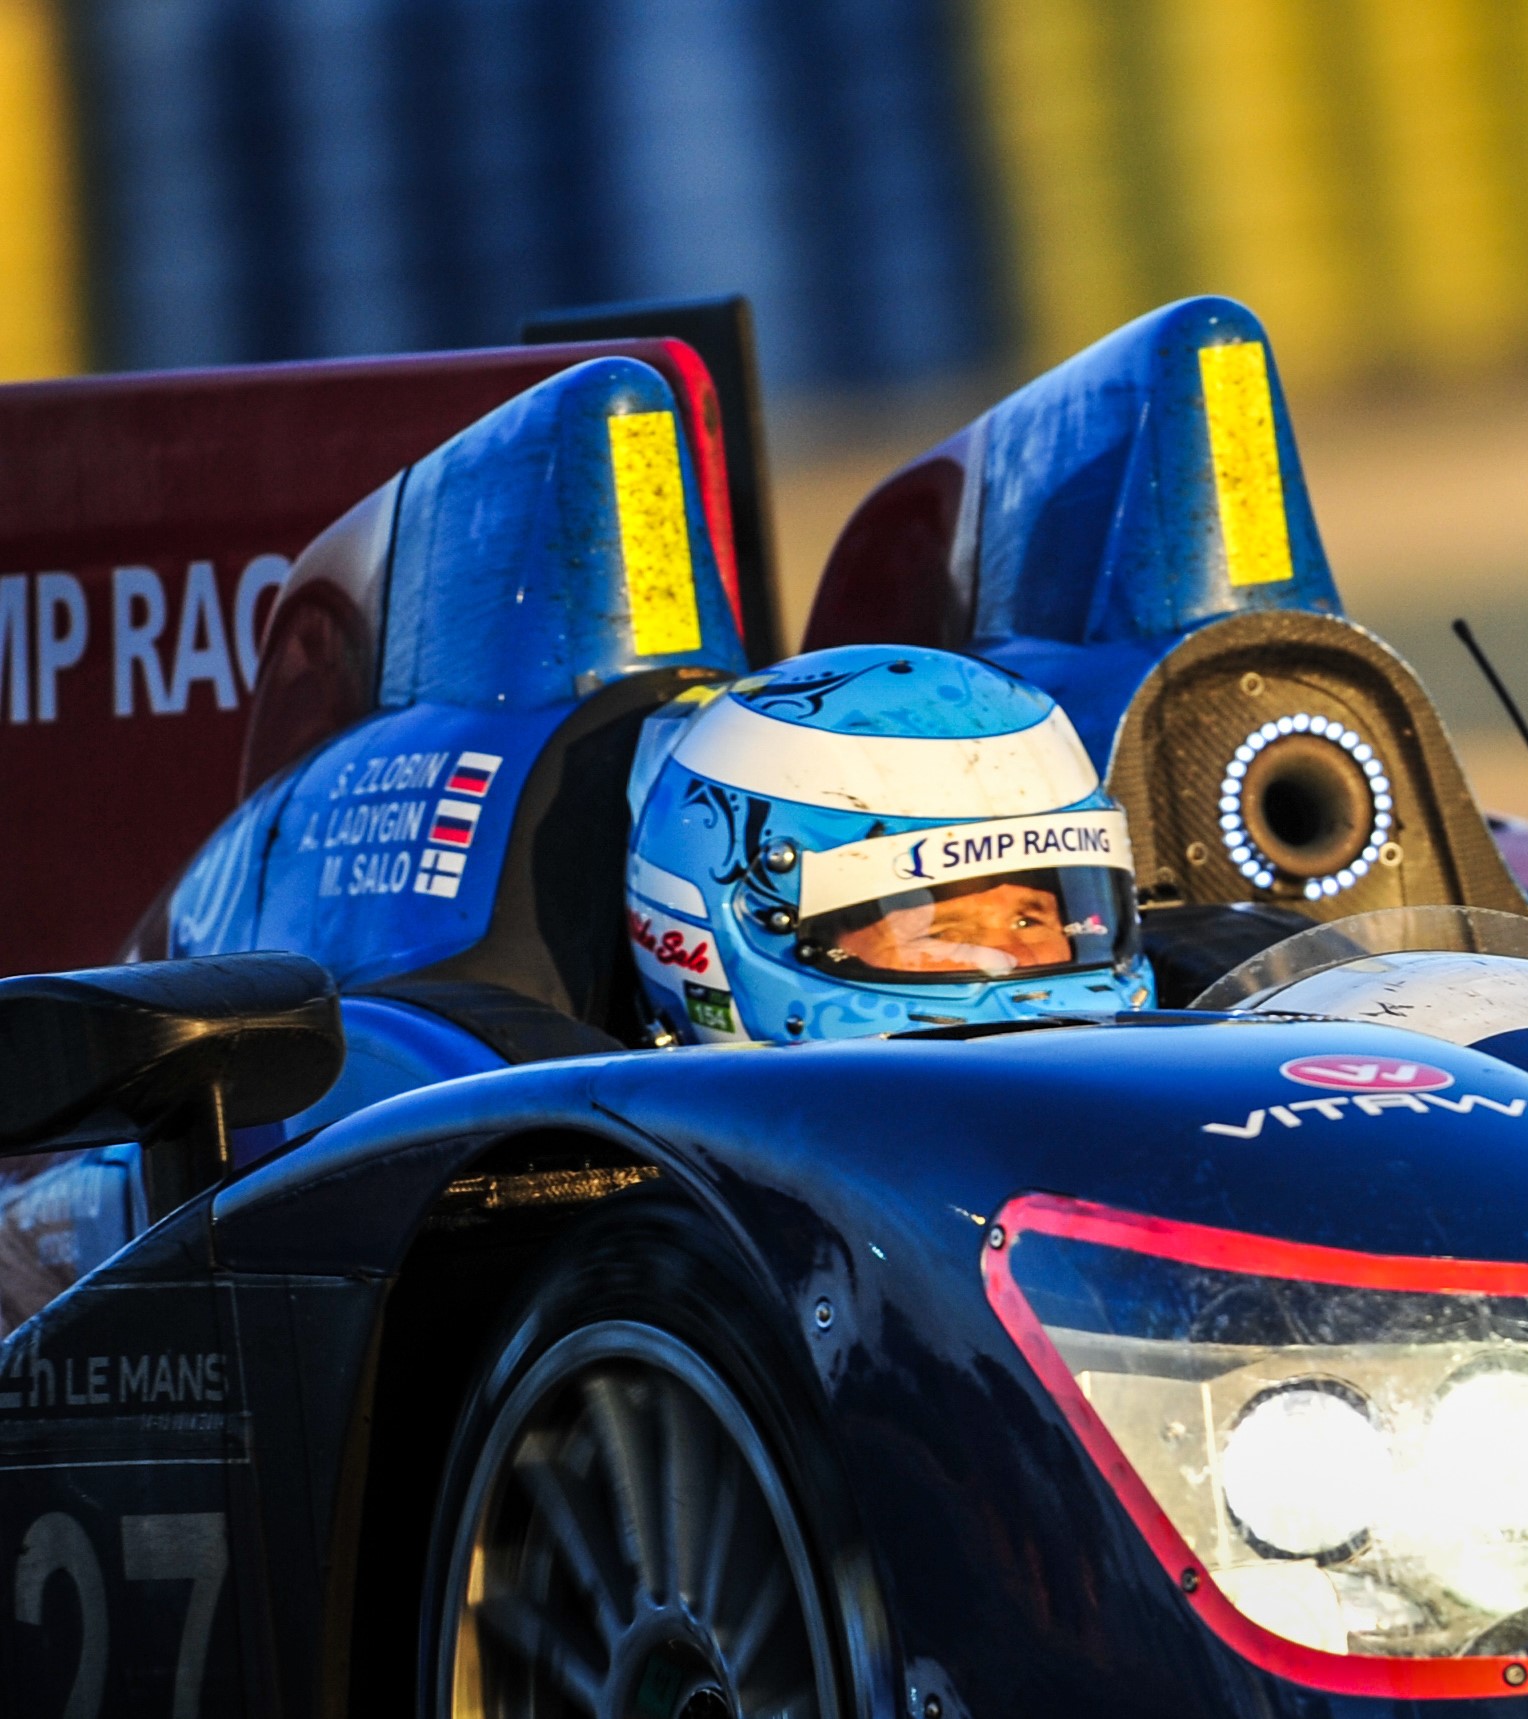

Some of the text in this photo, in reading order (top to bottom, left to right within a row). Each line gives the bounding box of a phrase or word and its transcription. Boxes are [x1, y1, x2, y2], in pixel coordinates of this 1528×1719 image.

[352, 751, 450, 796] ZLOBIN
[323, 800, 427, 848] LADYGIN
[943, 827, 1111, 868] SMP RACING
[348, 850, 412, 896] SALO
[66, 1356, 112, 1405] LE
[119, 1352, 228, 1402] MANS
[14, 1511, 229, 1719] 27
